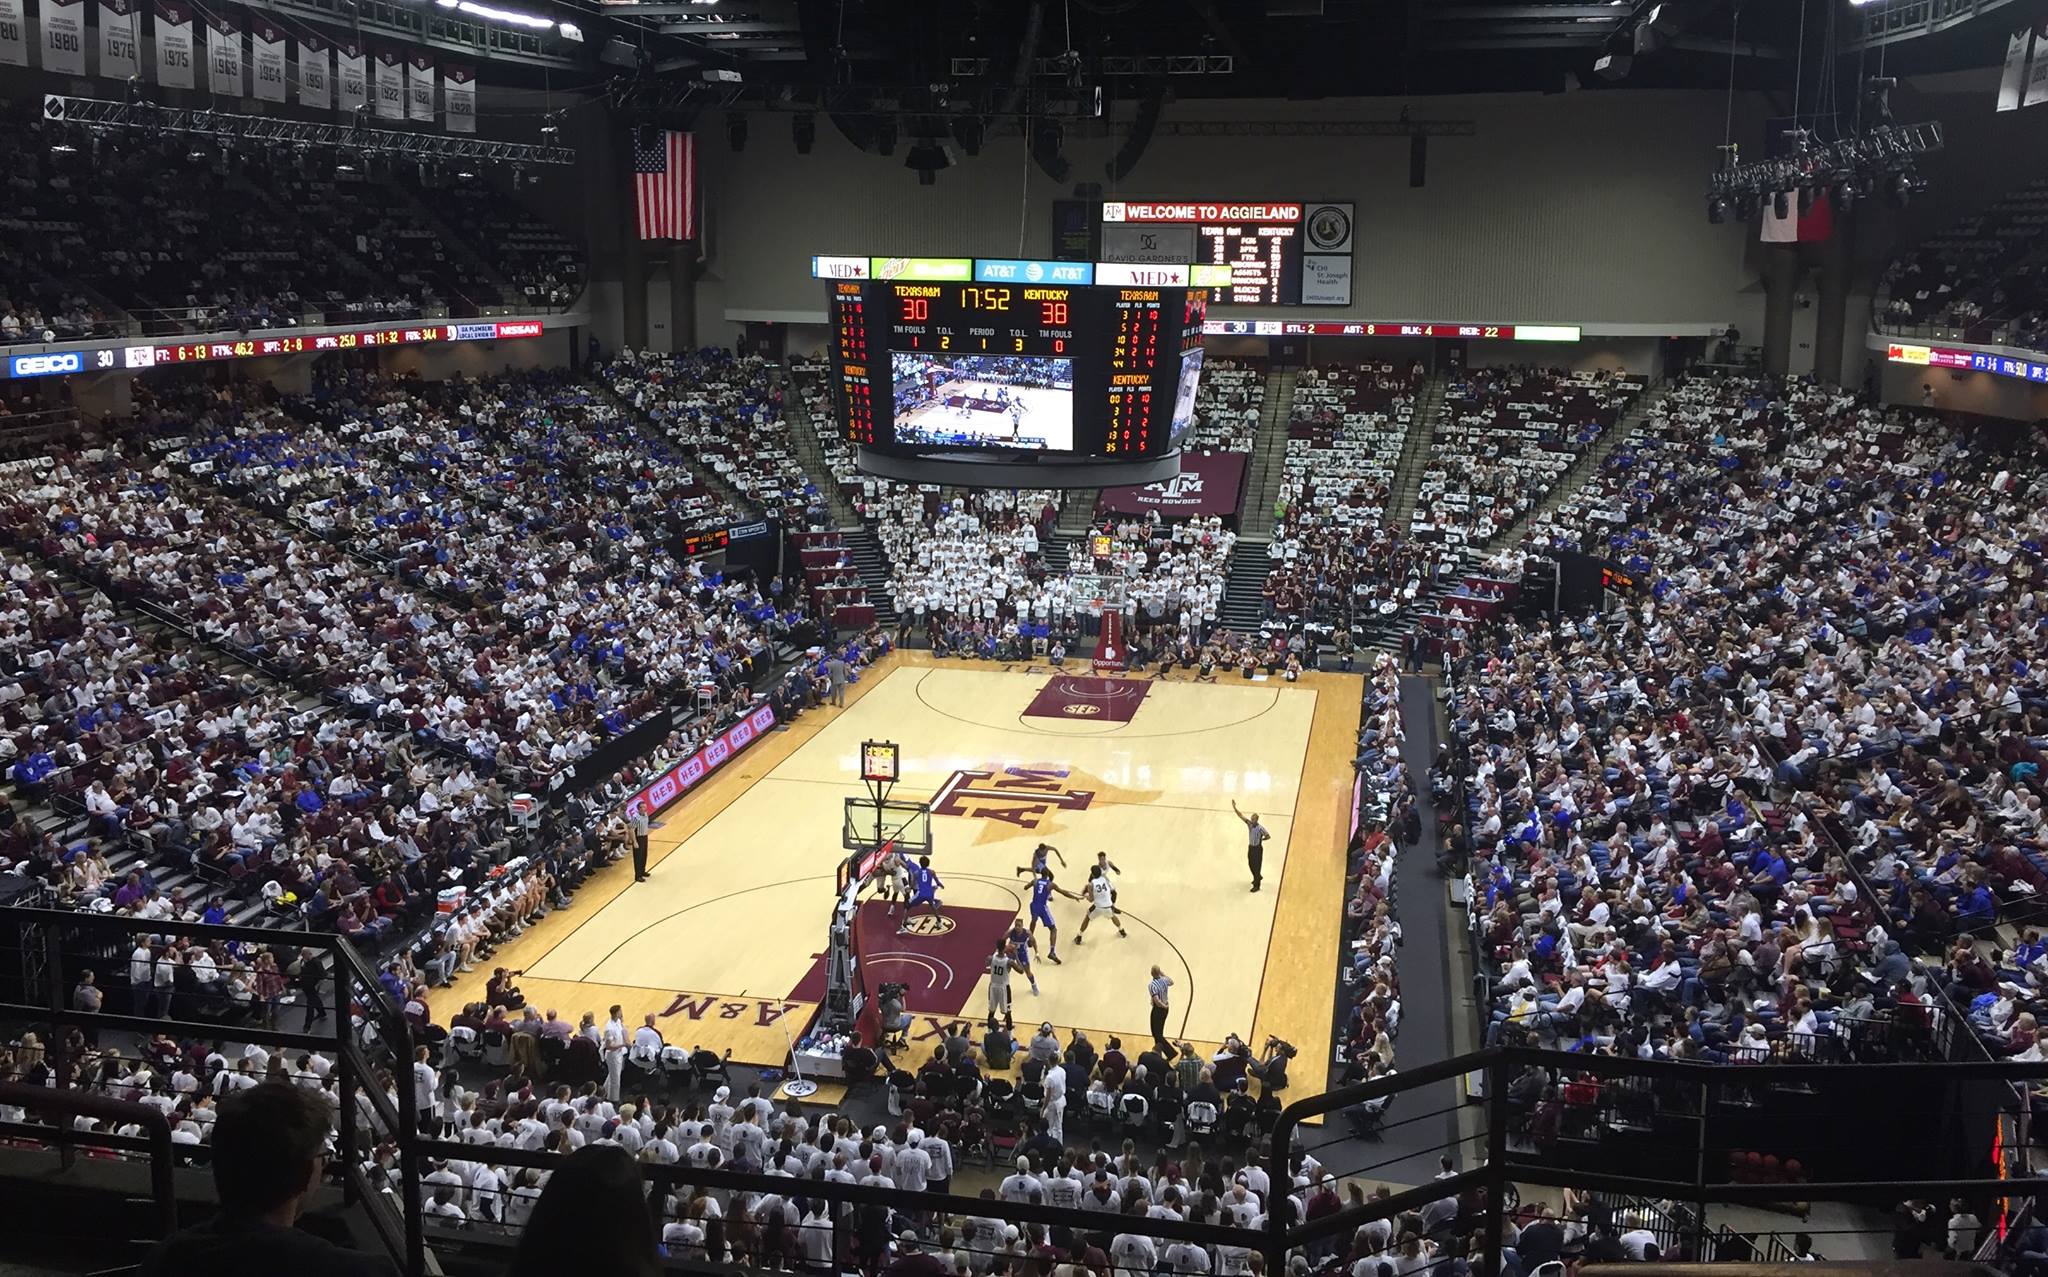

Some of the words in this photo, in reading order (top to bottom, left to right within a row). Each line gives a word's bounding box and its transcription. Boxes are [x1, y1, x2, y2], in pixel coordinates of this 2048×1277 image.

[0, 22, 18, 41] 80
[49, 31, 79, 52] 1980
[107, 39, 136, 60] 1976
[163, 49, 189, 67] 1975
[215, 58, 238, 76] 1969
[259, 64, 281, 83] 1964
[305, 72, 324, 90] 1951
[1127, 206, 1196, 219] WELCOME
[1198, 206, 1218, 219] TO
[1220, 206, 1299, 220] AGGIELAND
[1258, 227, 1294, 236] KENTUCKY
[829, 263, 852, 278] MED
[984, 265, 1016, 278] AT&T
[1052, 267, 1085, 280] AT&T
[1130, 271, 1168, 285] MED
[1024, 289, 1069, 301] KENTUCKY
[1272, 286, 1278, 294] 4
[962, 288, 1010, 310] 17:52
[904, 299, 927, 320] 30
[1042, 302, 1068, 324] 38
[1123, 310, 1128, 320] 3
[1137, 311, 1141, 319] 1
[1149, 311, 1158, 320] 10
[500, 325, 539, 335] NISSAN
[905, 326, 926, 334] FOULS
[936, 327, 955, 335] T.O.L.
[1010, 329, 1029, 337] T.O.L.
[1121, 323, 1127, 332] 5
[1134, 323, 1140, 332] 2
[1153, 323, 1157, 331] 1
[1233, 322, 1247, 333] 30
[1286, 324, 1305, 333] STL:
[1308, 325, 1315, 334] 2
[1343, 325, 1363, 334] AST:
[1368, 325, 1375, 334] 8
[1401, 326, 1422, 335] BLK:
[1425, 326, 1432, 335] 4
[1459, 327, 1480, 336] REB:
[1484, 328, 1498, 337] 22
[1051, 330, 1073, 338] FOULS
[1117, 335, 1126, 344] 10
[1132, 335, 1138, 344] 0
[1149, 335, 1156, 344] 2
[155, 350, 170, 361] FT:
[212, 345, 233, 356] FT%:
[234, 342, 254, 356] 46.2
[264, 341, 280, 352] 3PT:
[339, 335, 356, 347] 25.0
[423, 329, 437, 340] 34.4
[913, 337, 918, 348] 1
[941, 336, 950, 349] 2
[982, 338, 987, 349] 1
[1015, 339, 1023, 351] 3
[1055, 340, 1064, 352] 0
[1114, 348, 1125, 357] 34
[1131, 347, 1137, 357] 2
[1146, 348, 1155, 356] 11
[97, 350, 113, 367] 30
[1113, 360, 1124, 368] 44
[1133, 360, 1136, 368] 1
[1148, 360, 1153, 368] 4
[16, 355, 78, 374] GEICO
[1113, 375, 1149, 385] KENTUCKY
[1110, 395, 1120, 404] 00
[1127, 394, 1133, 404] 2
[1142, 394, 1150, 403] 10
[1114, 407, 1120, 416] 3
[1113, 419, 1118, 428] 5
[1142, 418, 1147, 427] 2
[1109, 431, 1117, 440] 13
[1124, 430, 1130, 439] 0
[1106, 443, 1116, 452] 35
[1140, 442, 1146, 450] 5
[1137, 496, 1160, 504] REED
[1093, 659, 1122, 667] Opportun
[1067, 705, 1099, 714] SEC
[922, 873, 928, 882] 0
[1038, 885, 1044, 894] 3
[1095, 883, 1107, 893] 34
[993, 965, 1004, 976] 10
[658, 994, 800, 1027] A&M
